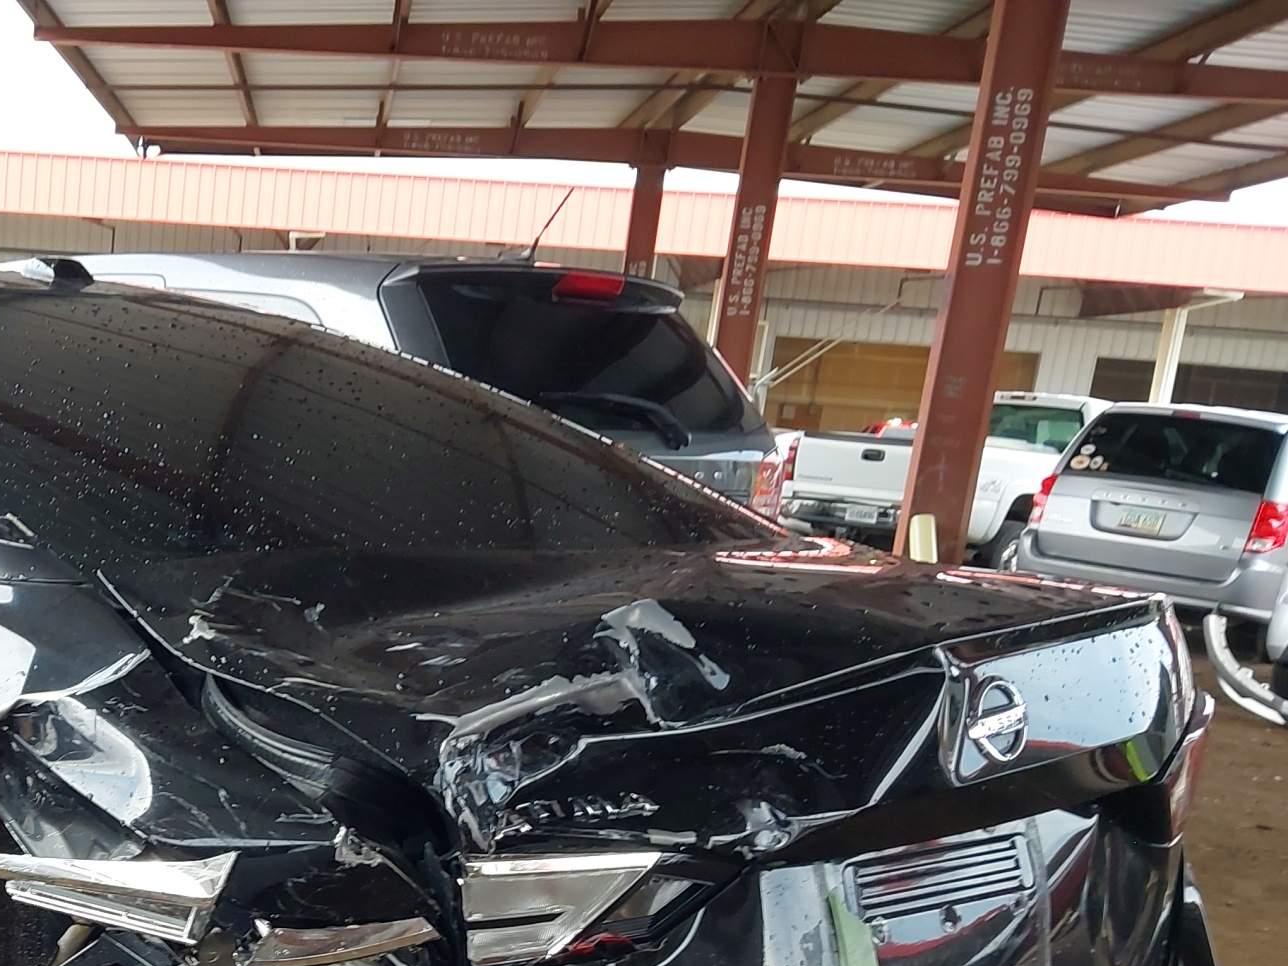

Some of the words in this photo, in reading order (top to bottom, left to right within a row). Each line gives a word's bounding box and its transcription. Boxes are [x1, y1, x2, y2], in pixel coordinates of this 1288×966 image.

[975, 136, 1005, 215] PREFAB
[986, 88, 1034, 265] 1-866-799-0969
[731, 234, 749, 285] PREFAB
